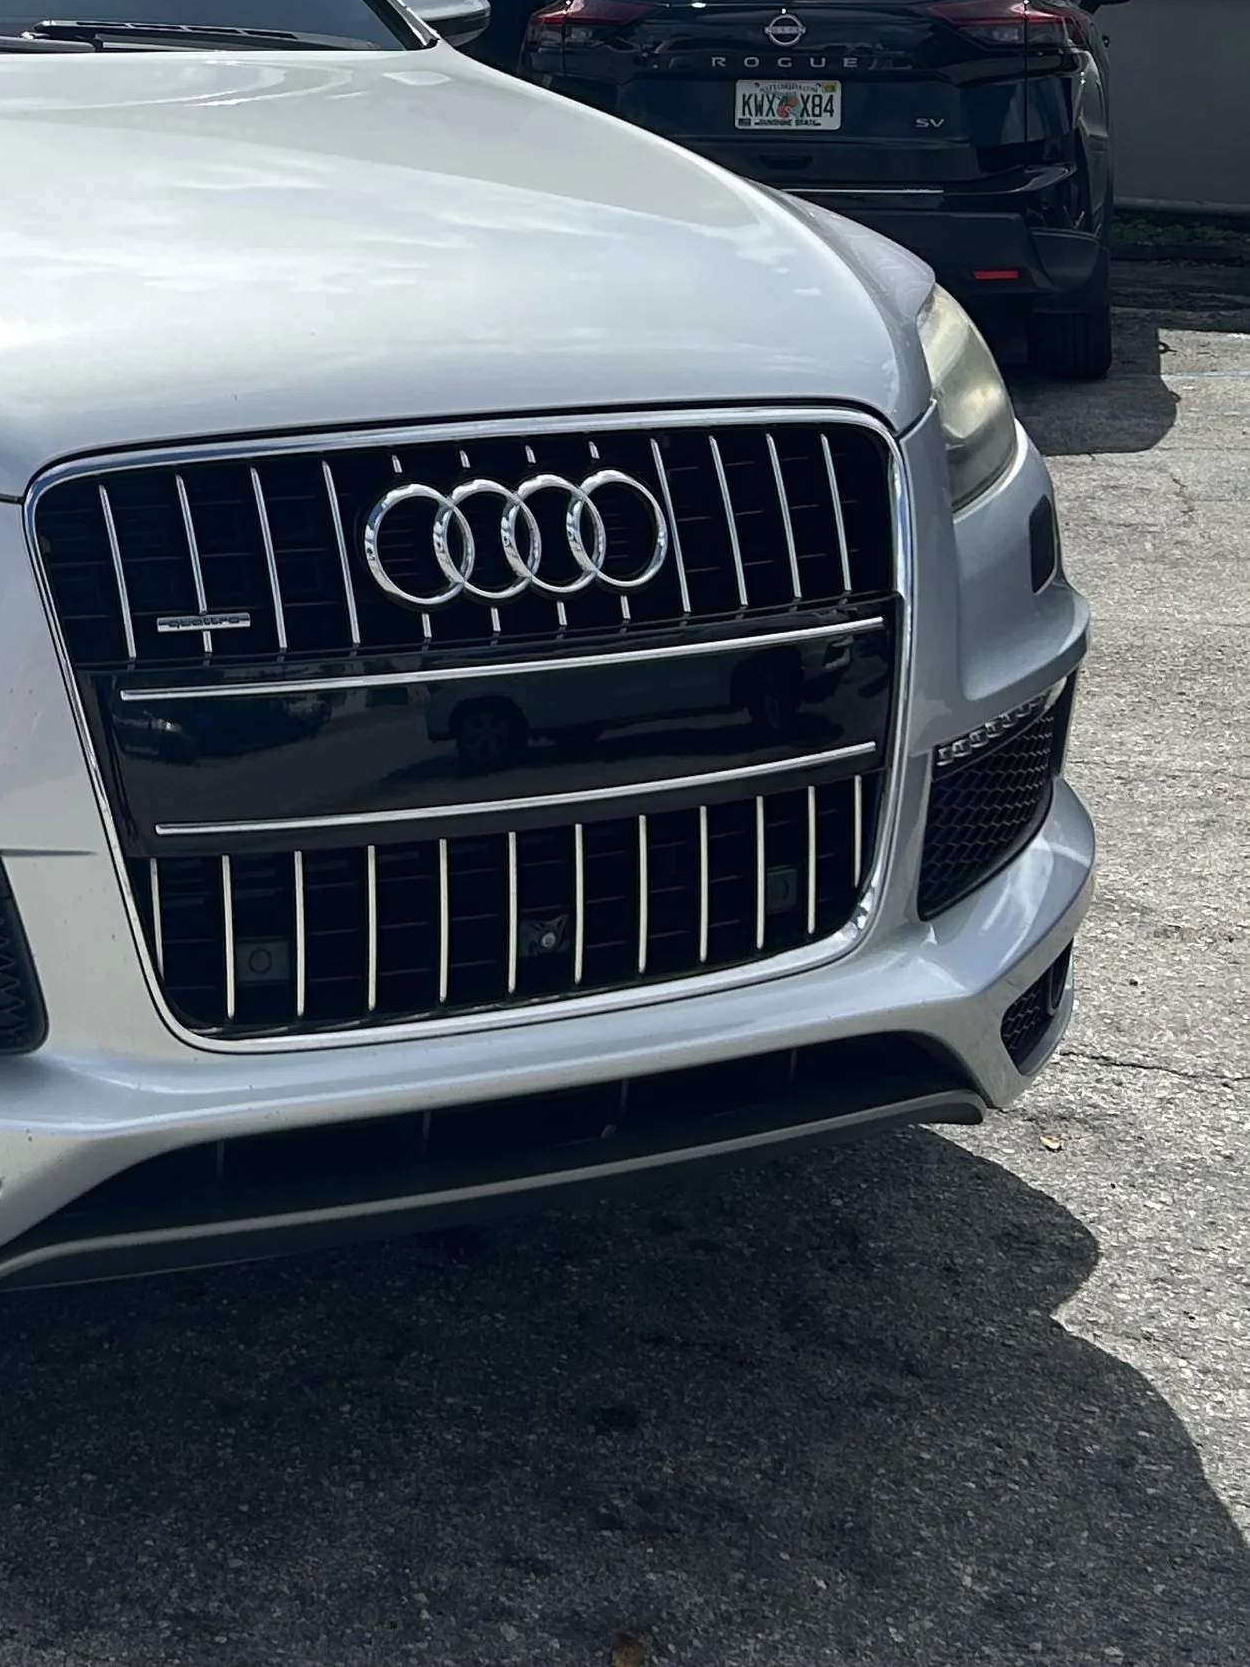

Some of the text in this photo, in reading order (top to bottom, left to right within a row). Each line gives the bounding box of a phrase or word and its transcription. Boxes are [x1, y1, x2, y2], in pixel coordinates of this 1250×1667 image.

[711, 57, 859, 68] ROGUE
[742, 93, 776, 117] KWX
[915, 118, 945, 128] SV
